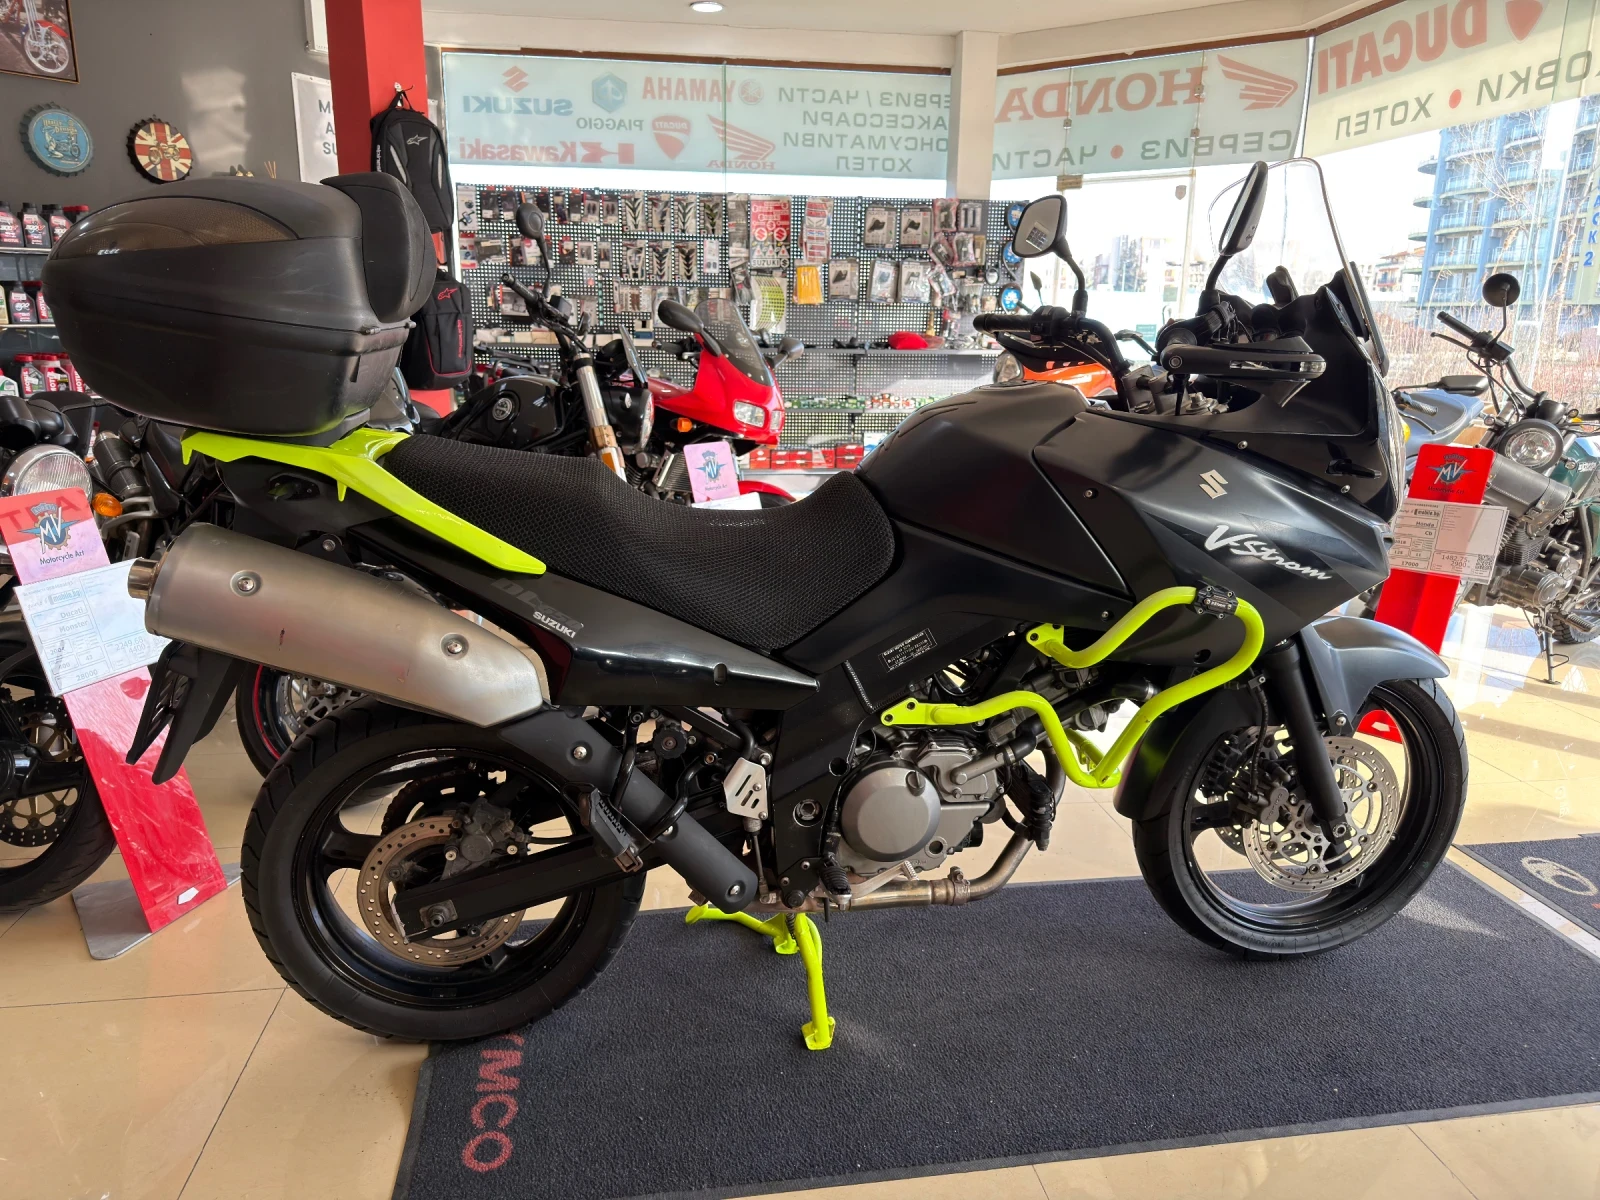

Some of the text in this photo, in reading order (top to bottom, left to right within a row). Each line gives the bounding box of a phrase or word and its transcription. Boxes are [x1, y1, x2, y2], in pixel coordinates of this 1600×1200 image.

[752, 259, 780, 267] SUZUKI
[39, 549, 85, 566] Motorcycle Art
[60, 606, 84, 619] Ducati
[60, 620, 89, 633] Monster
[533, 611, 576, 639] SUZUKI
[75, 669, 98, 682] 28000
